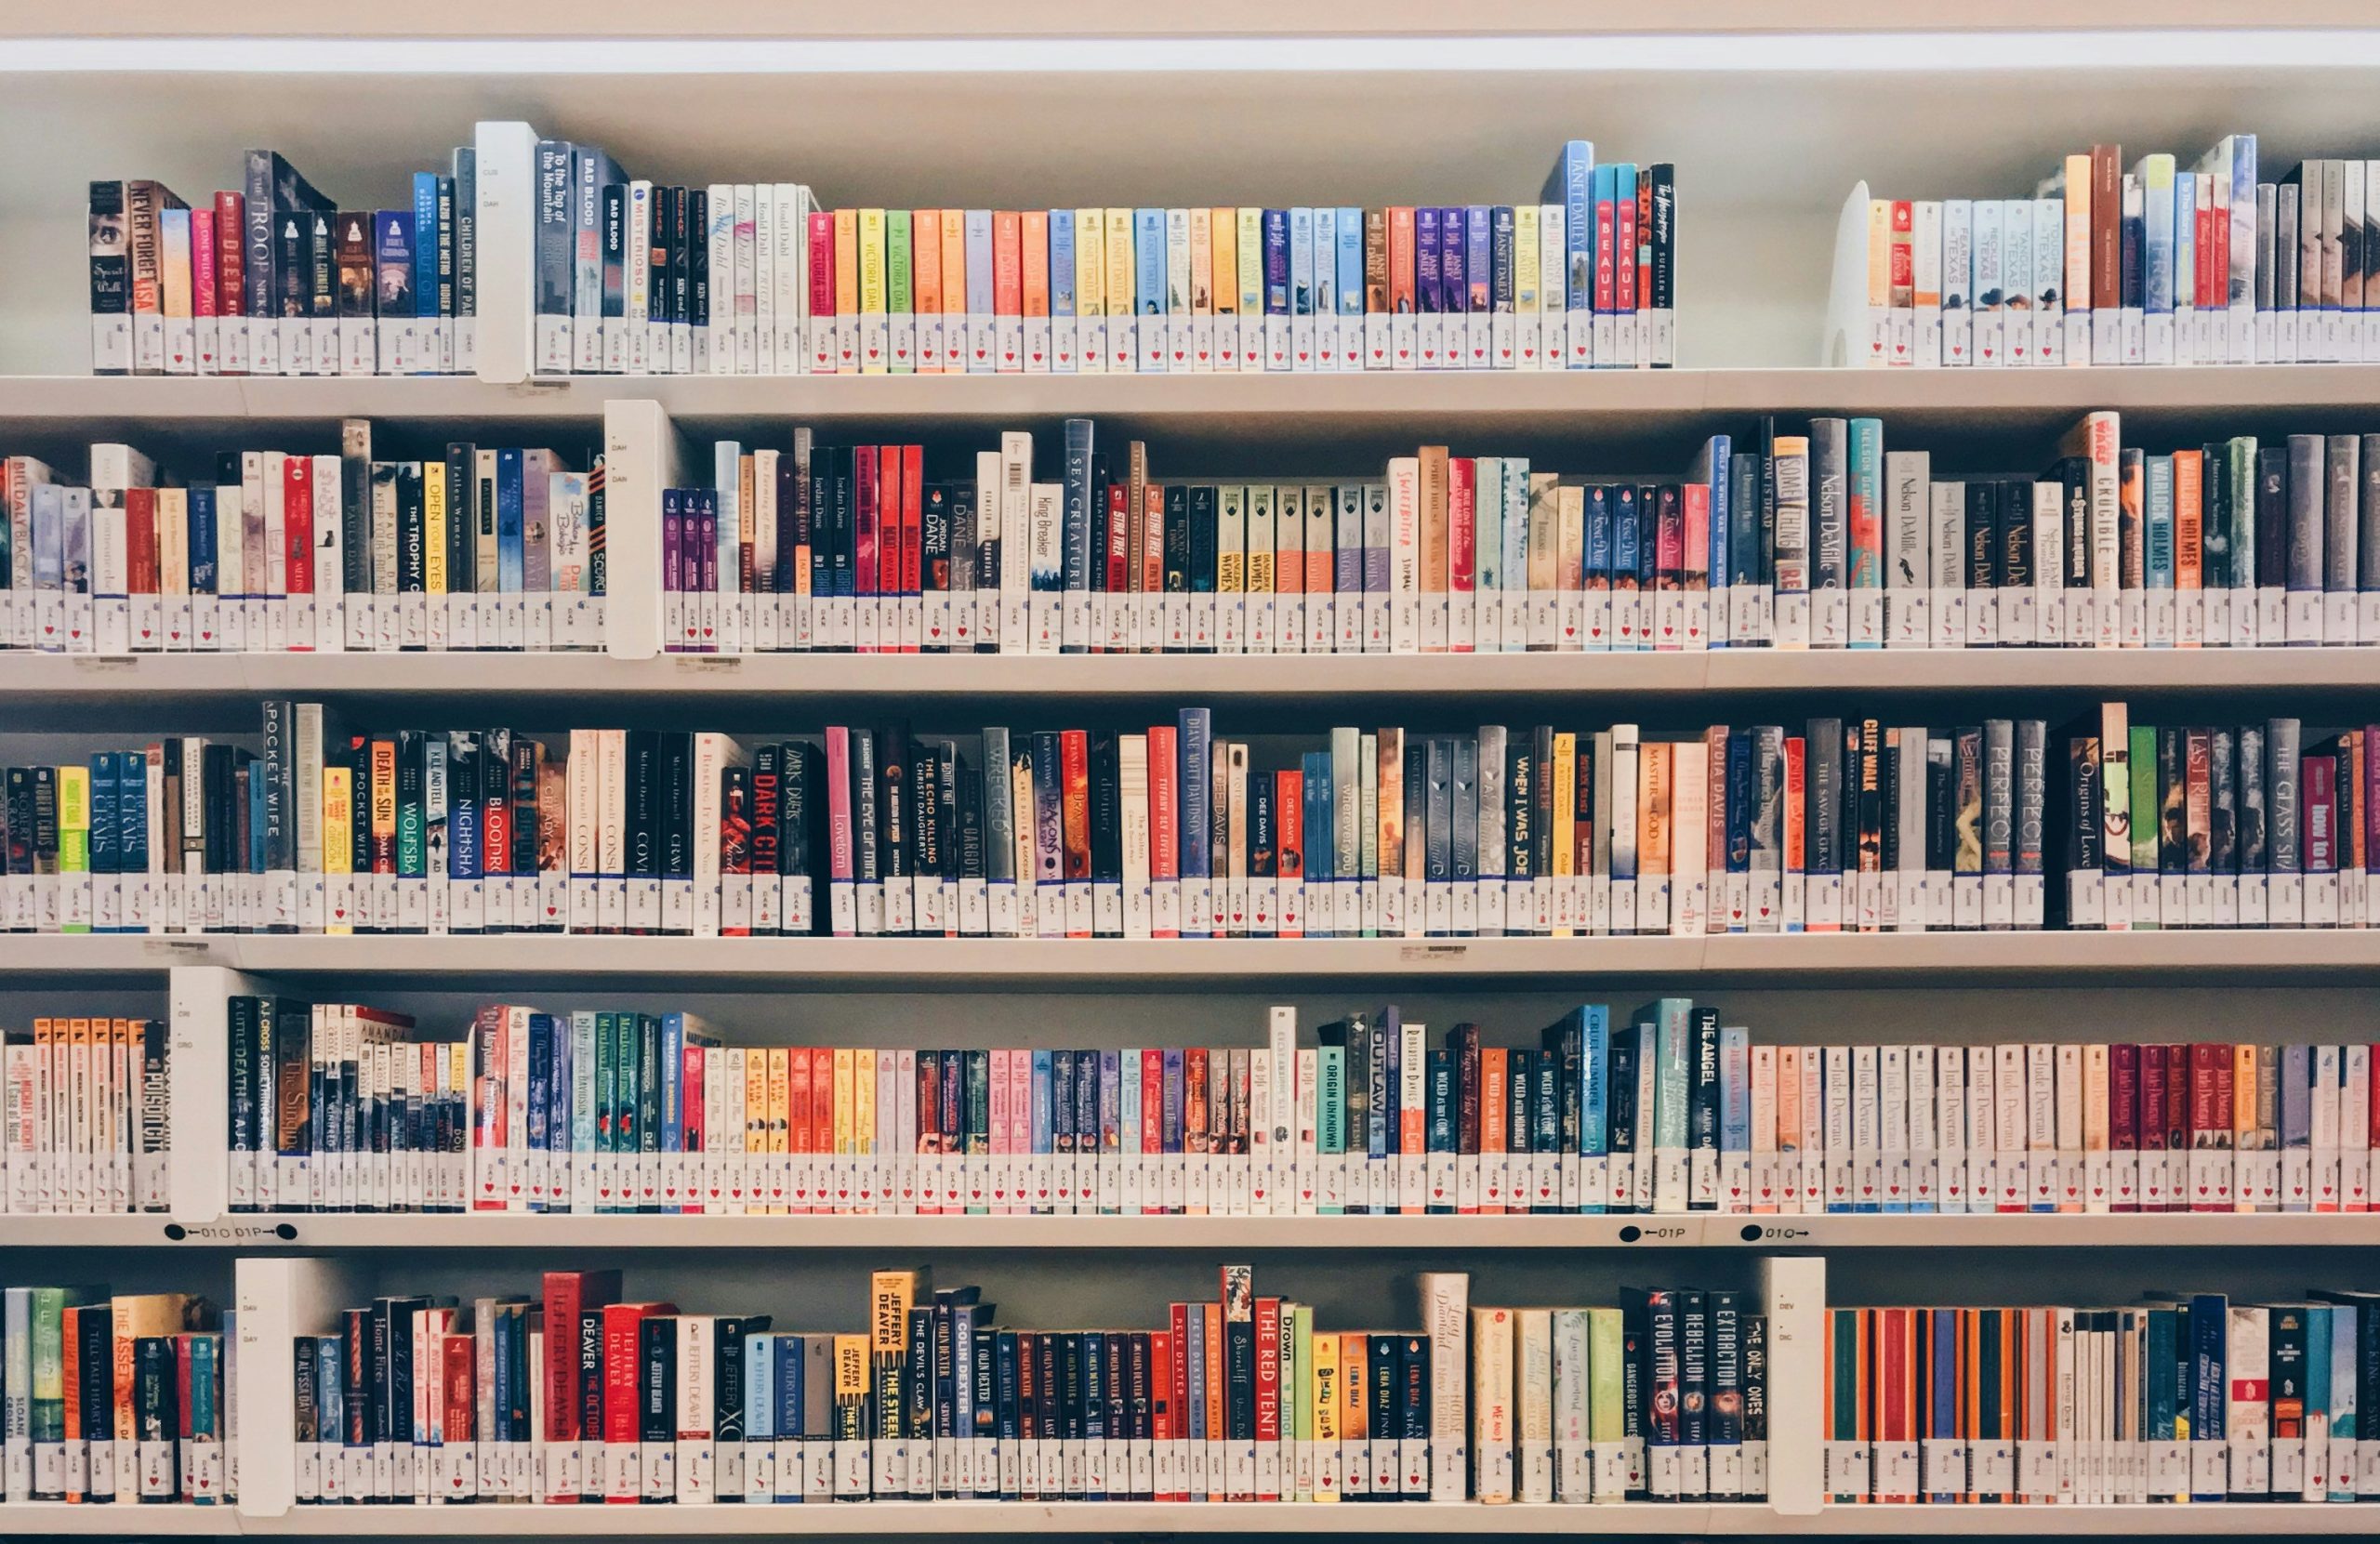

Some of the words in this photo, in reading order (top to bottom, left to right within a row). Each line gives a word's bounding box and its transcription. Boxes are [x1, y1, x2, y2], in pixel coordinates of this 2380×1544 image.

[543, 152, 552, 169] the
[555, 153, 565, 165] To
[584, 158, 594, 183] BAD
[254, 178, 264, 194] THE
[555, 169, 565, 186] the
[1572, 158, 1584, 198] JANET
[131, 188, 150, 231] NEVER
[543, 173, 554, 223] Mountain
[553, 191, 565, 207] Top
[585, 187, 595, 225] BLOOD
[610, 199, 618, 218] BAD
[555, 211, 566, 223] of
[759, 202, 768, 229] Roald
[1571, 203, 1584, 248] DAILEY
[252, 197, 272, 273] TROOP
[461, 217, 471, 272] CHILDREN
[610, 220, 618, 250] BLOOD
[634, 203, 643, 285] MISTERIOSO
[759, 233, 768, 257] Dahl
[136, 233, 156, 283] FORGET
[866, 243, 876, 284] VICTORIA
[1949, 238, 1958, 284] TEXAS
[1958, 228, 1967, 284] FEARLESS
[133, 280, 151, 310] LISA
[256, 280, 267, 309] NICK
[462, 277, 471, 291] OF
[866, 288, 876, 311] DAHL
[12, 462, 26, 488] BILL
[1071, 458, 1082, 487] SEA
[430, 484, 441, 521] OPEN
[814, 477, 823, 504] Jordan
[1037, 497, 1051, 517] King
[1821, 474, 1840, 518] Nelson
[2151, 462, 2168, 520] WARLOCK
[13, 490, 26, 527] DALY
[814, 508, 823, 529] Dane
[2097, 478, 2114, 553] CRUCIBLE
[431, 524, 440, 553] YOUR
[954, 504, 966, 548] DANE
[966, 510, 974, 544] JORDAN
[1038, 520, 1051, 557] Breaker
[1070, 497, 1082, 588] CREATURE
[15, 531, 27, 571] BLACK
[1821, 521, 1840, 571] DeMille
[2151, 522, 2169, 570] HOLMES
[430, 556, 441, 589] EYES
[1187, 719, 1201, 749] DIANE
[1864, 719, 1877, 752] CLIFF
[377, 751, 392, 785] DEATH
[431, 752, 441, 769] KILL
[1187, 753, 1201, 781] MOTT
[1713, 734, 1725, 782] LYDIA
[1863, 756, 1877, 791] WALK
[431, 772, 441, 786] AND
[988, 749, 1006, 832] WRECKED
[1515, 757, 1528, 794] WHEN
[2078, 762, 2095, 817] Origins
[358, 772, 366, 826] POCKET
[377, 798, 392, 820] SUN
[431, 789, 441, 805] TELL
[926, 784, 934, 814] ECHO
[1187, 785, 1201, 835] DAVIDSON
[1714, 786, 1725, 826] DAVIS
[2023, 747, 2041, 849] PERFECT
[1342, 785, 1354, 844] wherever
[1515, 808, 1528, 841] WAS
[2080, 820, 2093, 830] of
[358, 833, 366, 864] WIFE
[927, 819, 935, 864] KILLING
[2081, 836, 2095, 867] Love
[1340, 848, 1353, 871] you
[1514, 846, 1528, 875] JOE
[1589, 1014, 1599, 1051] CRUEL
[1701, 1015, 1715, 1037] THE
[1408, 1030, 1422, 1071] ROBERTSON
[1701, 1043, 1715, 1086] ANGEL
[1327, 1065, 1337, 1097] ORIGIN
[1372, 1030, 1383, 1113] OUTLAW
[1408, 1075, 1422, 1101] DAVIES
[1514, 1074, 1526, 1097] WICKED
[1589, 1056, 1599, 1106] SUMMER
[1859, 1070, 1871, 1092] Jude
[1945, 1071, 1957, 1092] Jude
[145, 1073, 162, 1123] POISON
[1327, 1102, 1338, 1147] UNKNOWN
[1514, 1115, 1525, 1147] MIDNIGHT
[1703, 1108, 1712, 1133] MARK
[1860, 1097, 1871, 1146] Deveraux
[1946, 1097, 1957, 1148] Deveraux
[235, 1227, 261, 1237] 01P
[1659, 1228, 1685, 1238] 01P
[117, 1308, 129, 1330] THE
[375, 1318, 385, 1352] Home
[879, 1294, 890, 1345] DEAVER
[891, 1292, 901, 1346] JEFFERY
[1261, 1308, 1275, 1340] THE
[1748, 1322, 1762, 1344] THE
[958, 1323, 968, 1362] COLIN
[1282, 1316, 1293, 1361] Drown
[1655, 1314, 1673, 1382] EVOLUTION
[1686, 1314, 1703, 1381] REBELLION
[1717, 1311, 1737, 1385] EXTRACTION
[117, 1337, 129, 1378] ASSET
[376, 1357, 385, 1383] Fires
[843, 1350, 852, 1387] DEAVER
[852, 1349, 860, 1388] JEFFERY
[917, 1342, 925, 1378] DEVIL'S
[1261, 1350, 1276, 1380] RED
[1748, 1350, 1761, 1380] ONLY
[298, 1361, 309, 1392] ALYSSA
[887, 1369, 898, 1394] THE
[959, 1365, 968, 1413] DEXTER
[1626, 1364, 1636, 1409] DANGEROUS
[299, 1394, 310, 1413] DAY
[916, 1382, 924, 1409] CLAW
[1261, 1390, 1276, 1435] TENT
[1748, 1386, 1762, 1415] ONES
[888, 1399, 899, 1439] STEEL
[1282, 1398, 1294, 1437] Junot
[1628, 1412, 1638, 1437] GAMES
